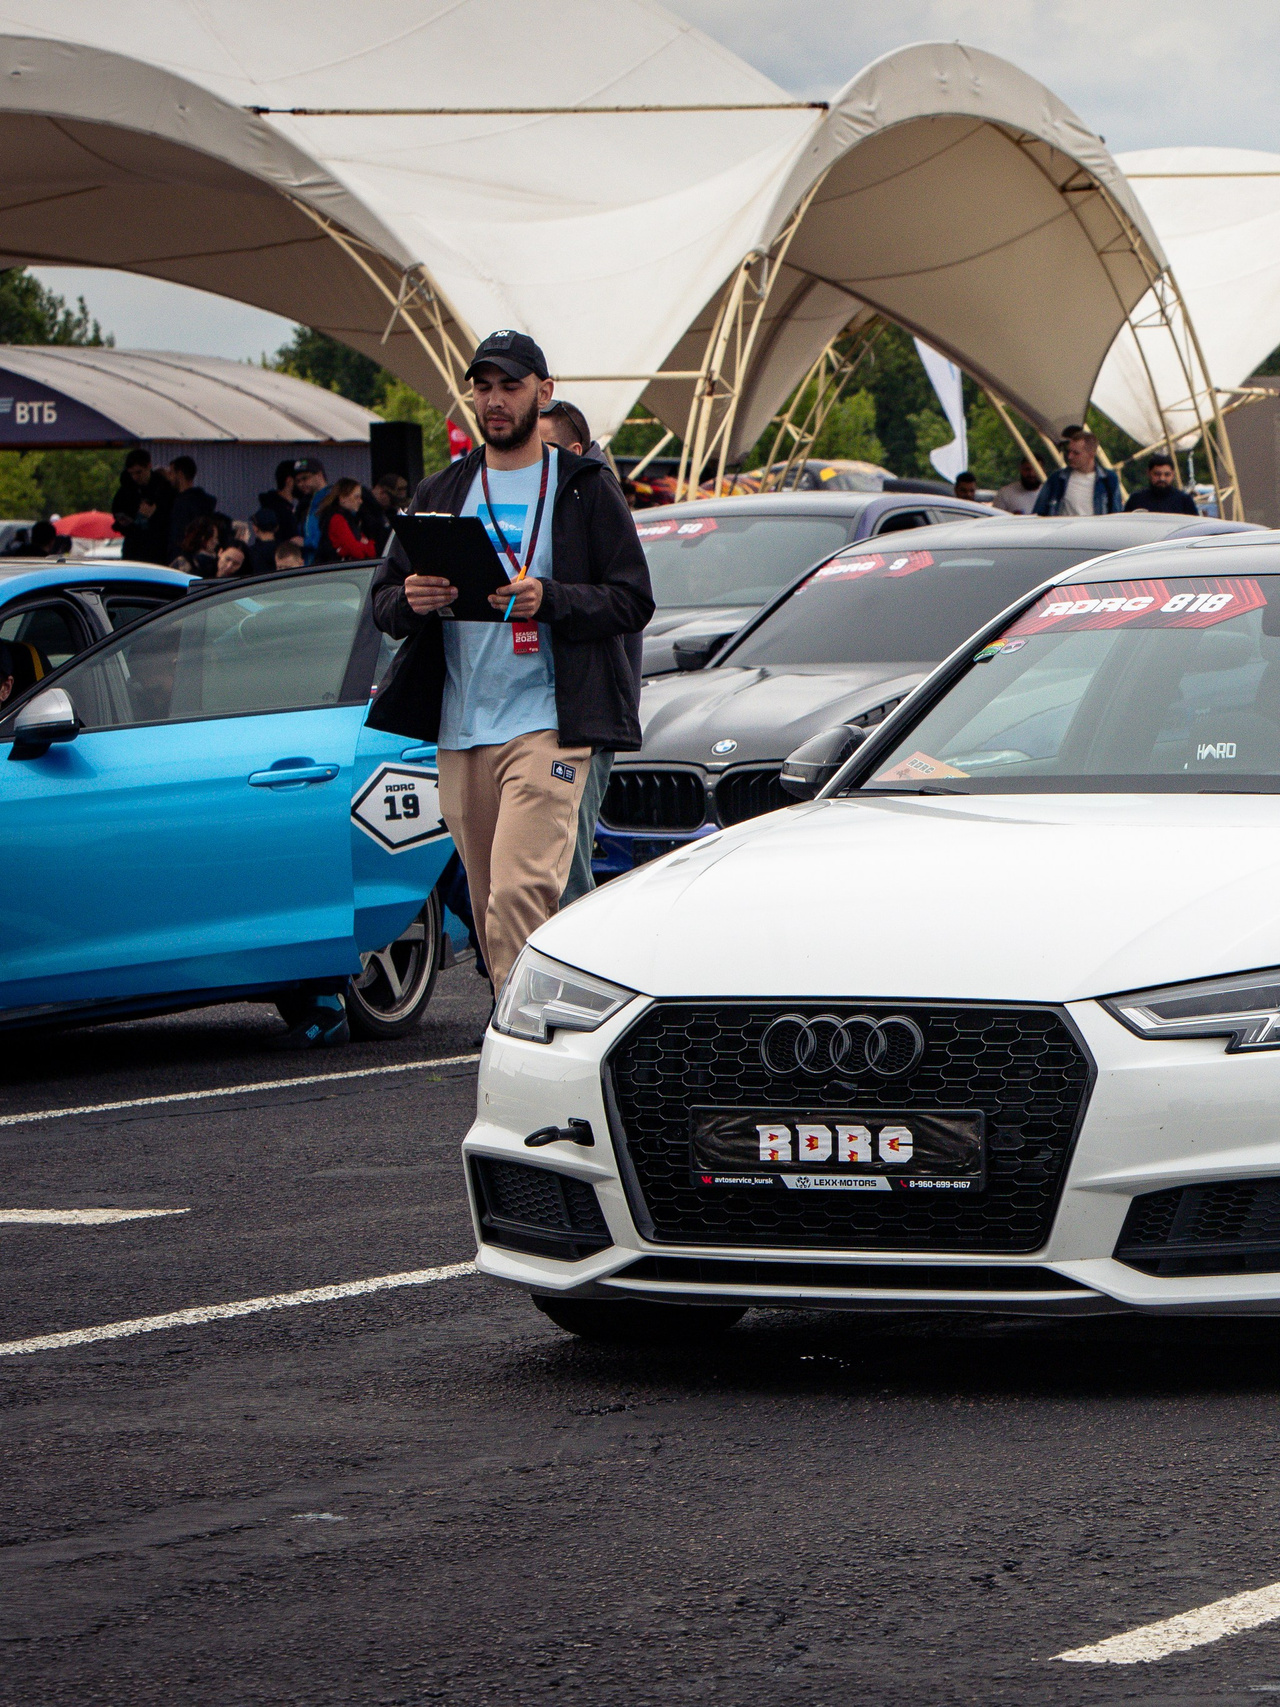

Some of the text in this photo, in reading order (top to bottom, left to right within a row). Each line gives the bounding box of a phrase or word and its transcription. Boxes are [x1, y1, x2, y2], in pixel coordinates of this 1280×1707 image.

[16, 401, 57, 424] ВТБ
[889, 558, 908, 570] 9
[1039, 593, 1234, 618] RDRC 818
[1197, 743, 1237, 760] HARD
[906, 758, 935, 775] RDRC
[385, 783, 416, 793] RDRC
[384, 794, 420, 821] 19
[756, 1124, 913, 1163] RDRC
